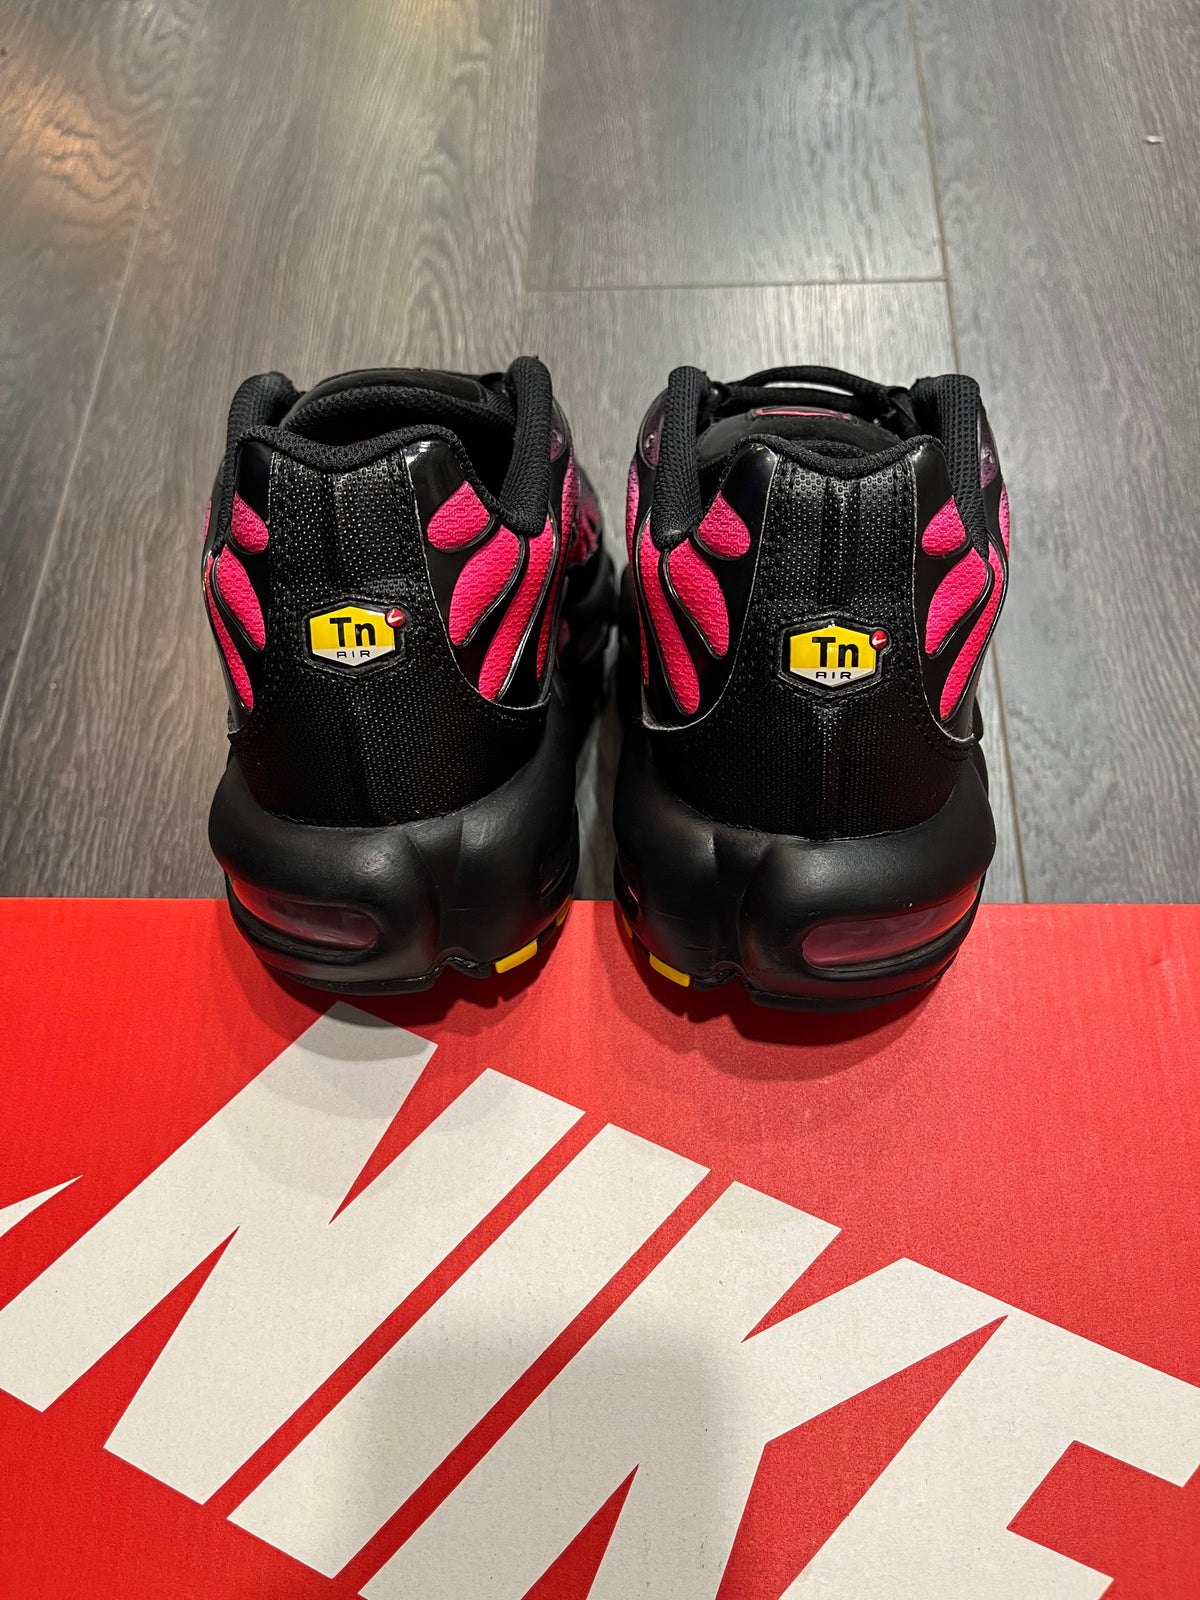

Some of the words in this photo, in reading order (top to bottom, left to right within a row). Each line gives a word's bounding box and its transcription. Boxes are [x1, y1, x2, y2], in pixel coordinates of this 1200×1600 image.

[329, 616, 376, 648] Tn
[336, 650, 371, 658] AIR
[811, 636, 859, 668] Tn
[815, 671, 852, 680] AIR
